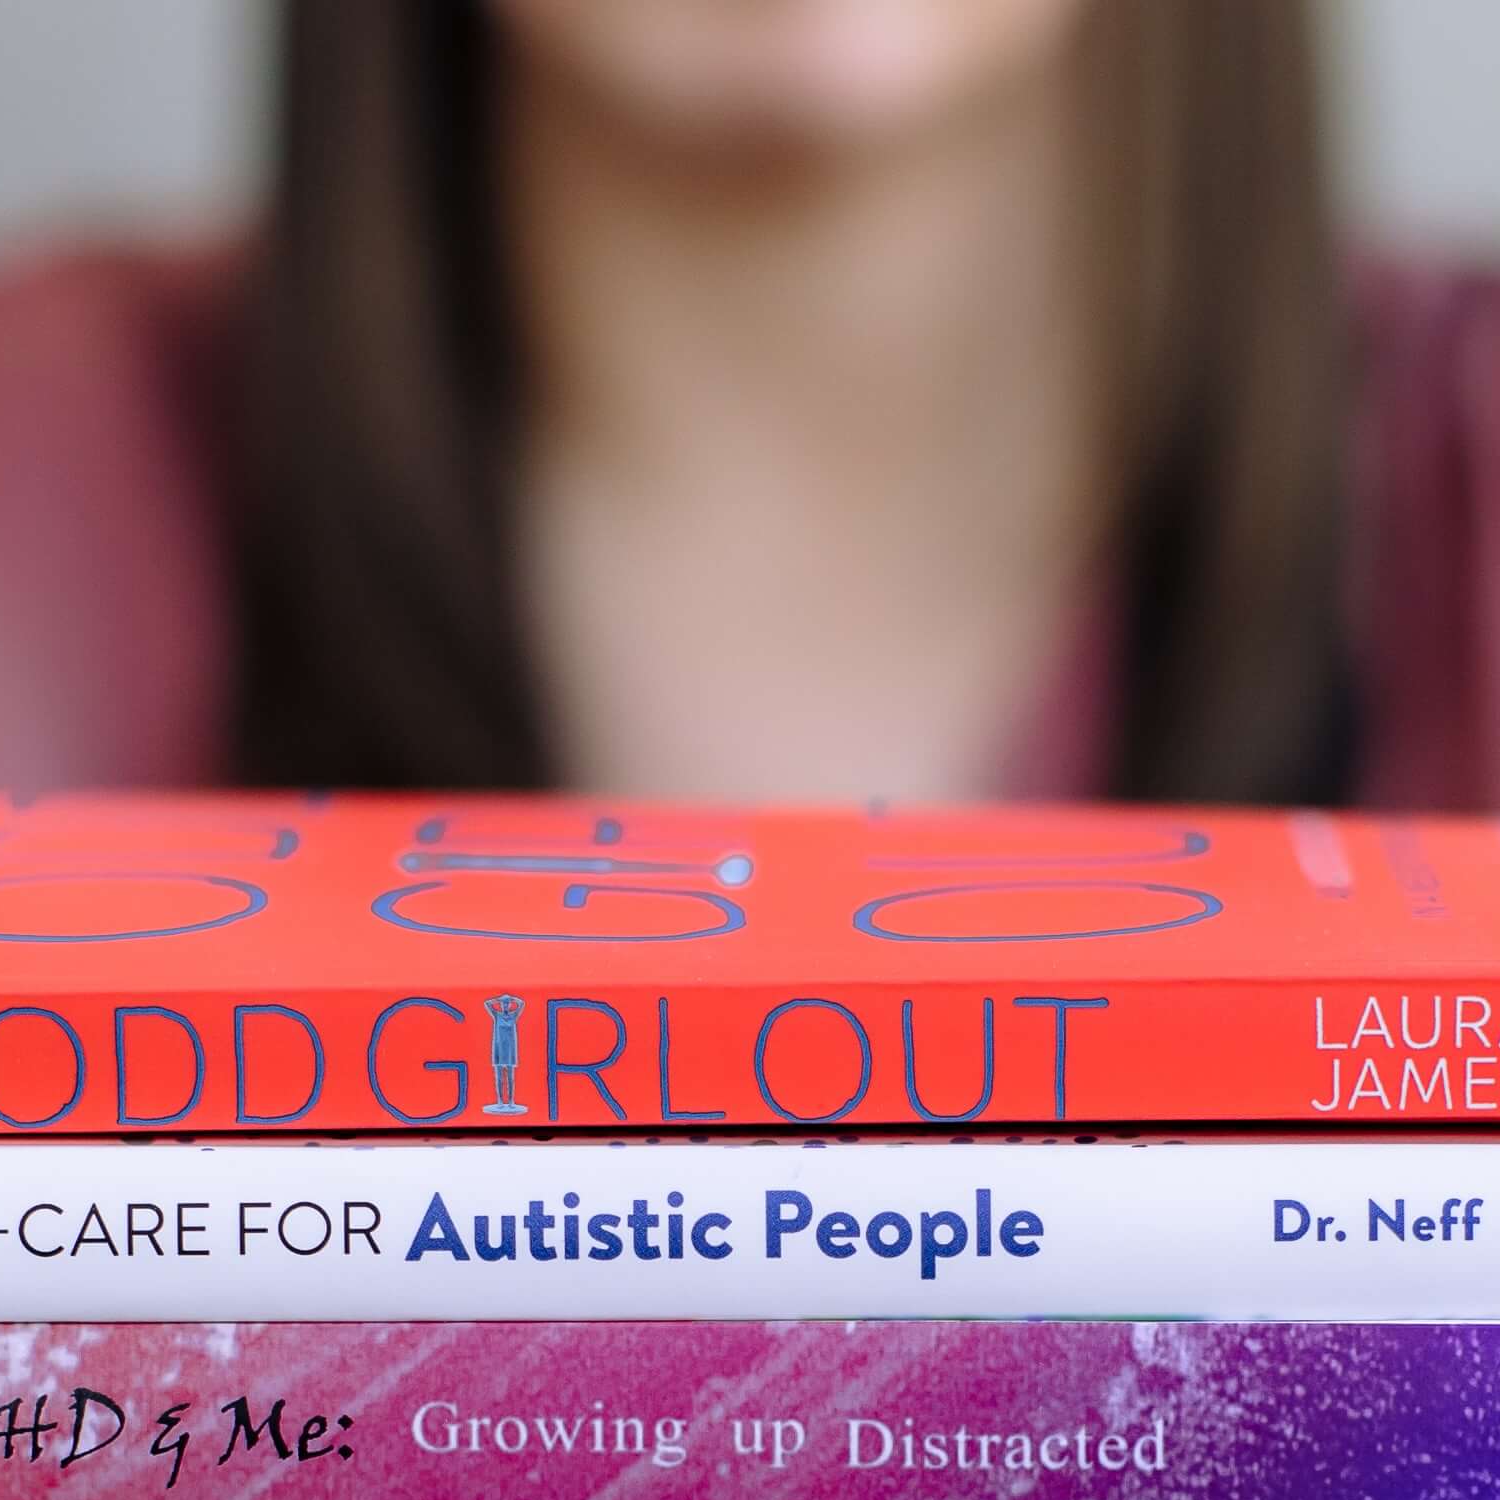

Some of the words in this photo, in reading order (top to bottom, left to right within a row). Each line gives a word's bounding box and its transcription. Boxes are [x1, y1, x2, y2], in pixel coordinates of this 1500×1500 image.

[367, 994, 727, 1126] GIRL
[753, 995, 1110, 1124] OUT
[239, 1201, 381, 1256] FOR
[404, 1191, 733, 1262] Autistic
[765, 1188, 1045, 1281] People
[1273, 1199, 1347, 1243] Dr.
[1368, 1198, 1484, 1242] Neff
[155, 1398, 191, 1488] &
[218, 1394, 355, 1464] Me:
[411, 1401, 687, 1465] Growing
[731, 1414, 806, 1470] up
[846, 1416, 1169, 1472] Distracted
